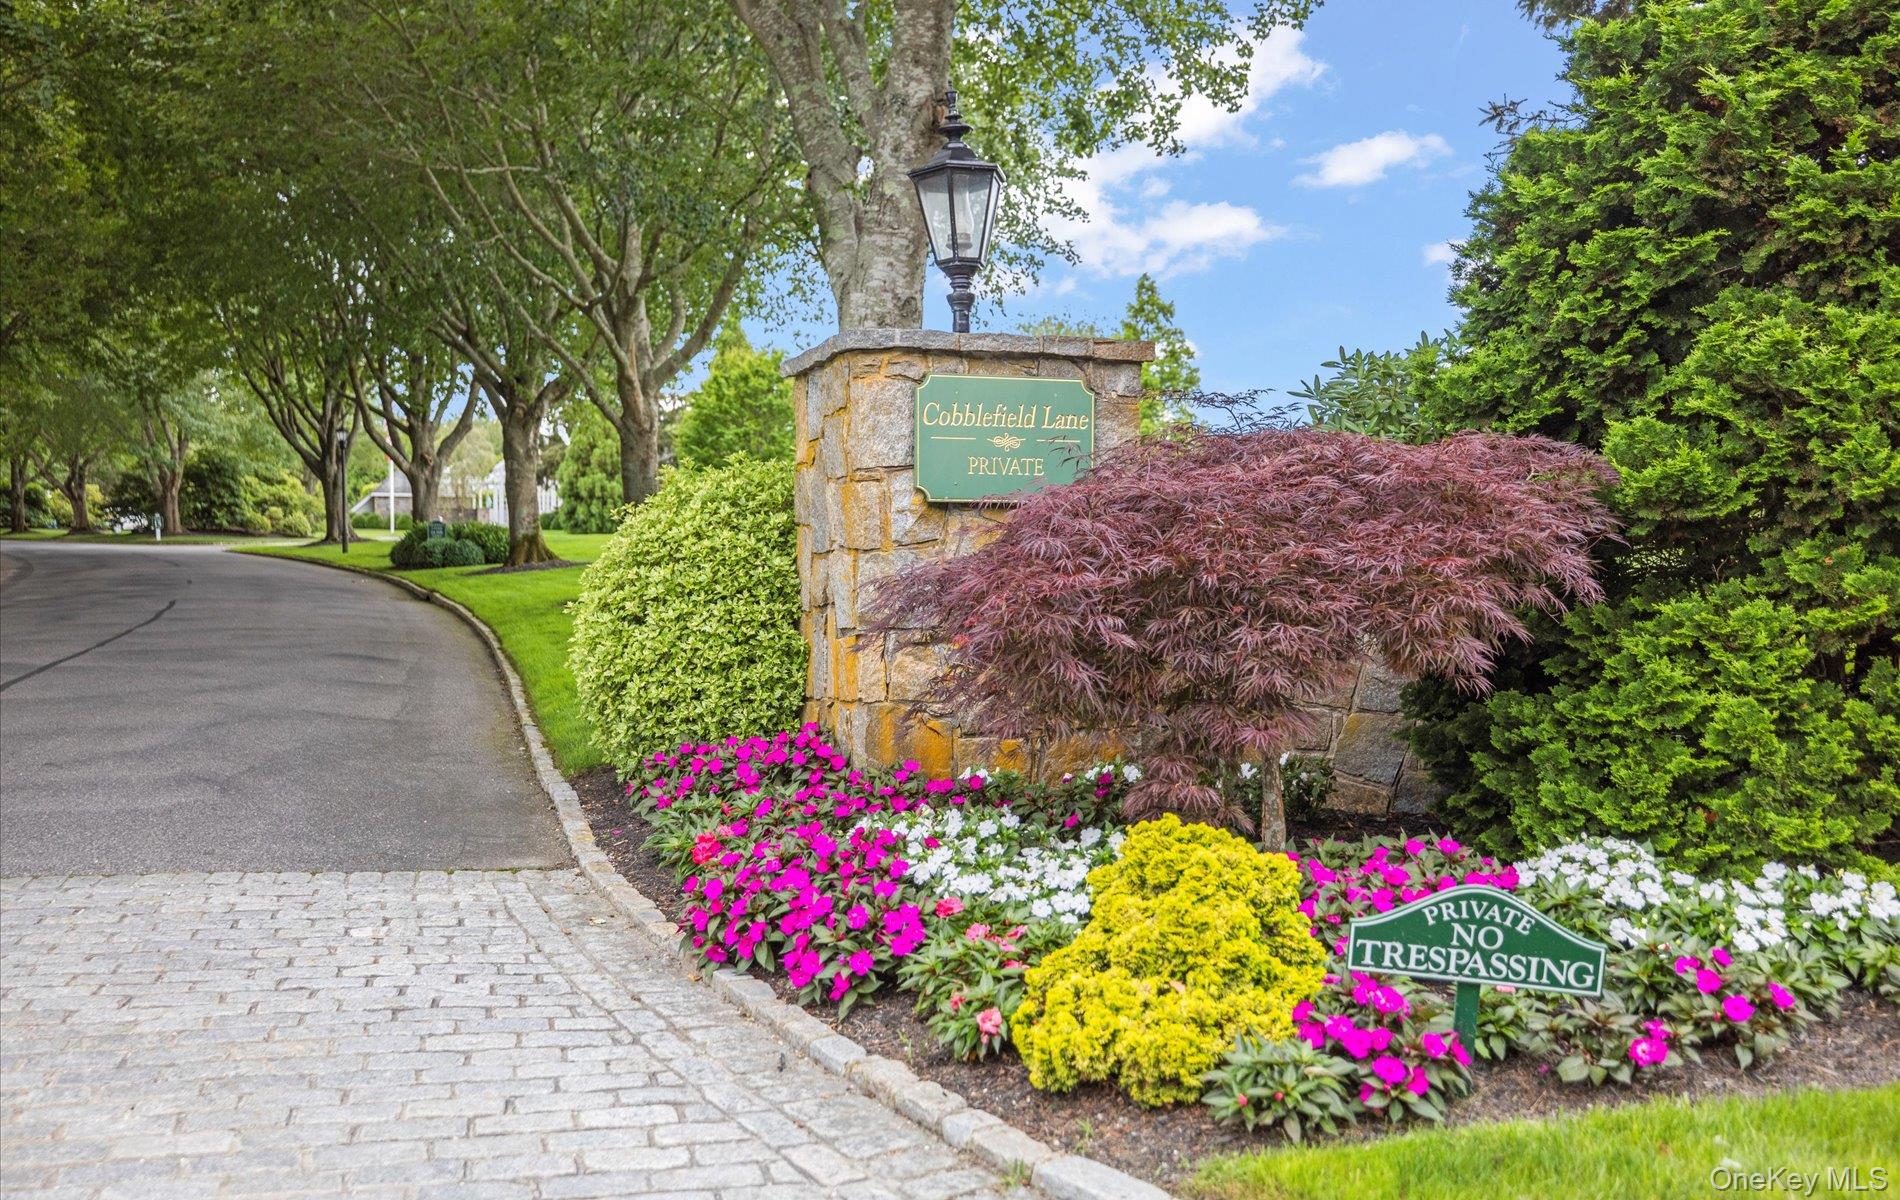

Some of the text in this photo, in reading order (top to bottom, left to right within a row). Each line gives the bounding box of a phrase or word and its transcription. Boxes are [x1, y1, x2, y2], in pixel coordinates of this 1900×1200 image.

[923, 402, 1089, 430] Cobblefield Lane
[967, 456, 1045, 476] PRIVATE
[1422, 900, 1535, 935] PRIVATE
[1451, 922, 1504, 950] NO
[1356, 939, 1595, 988] TRESPASSING
